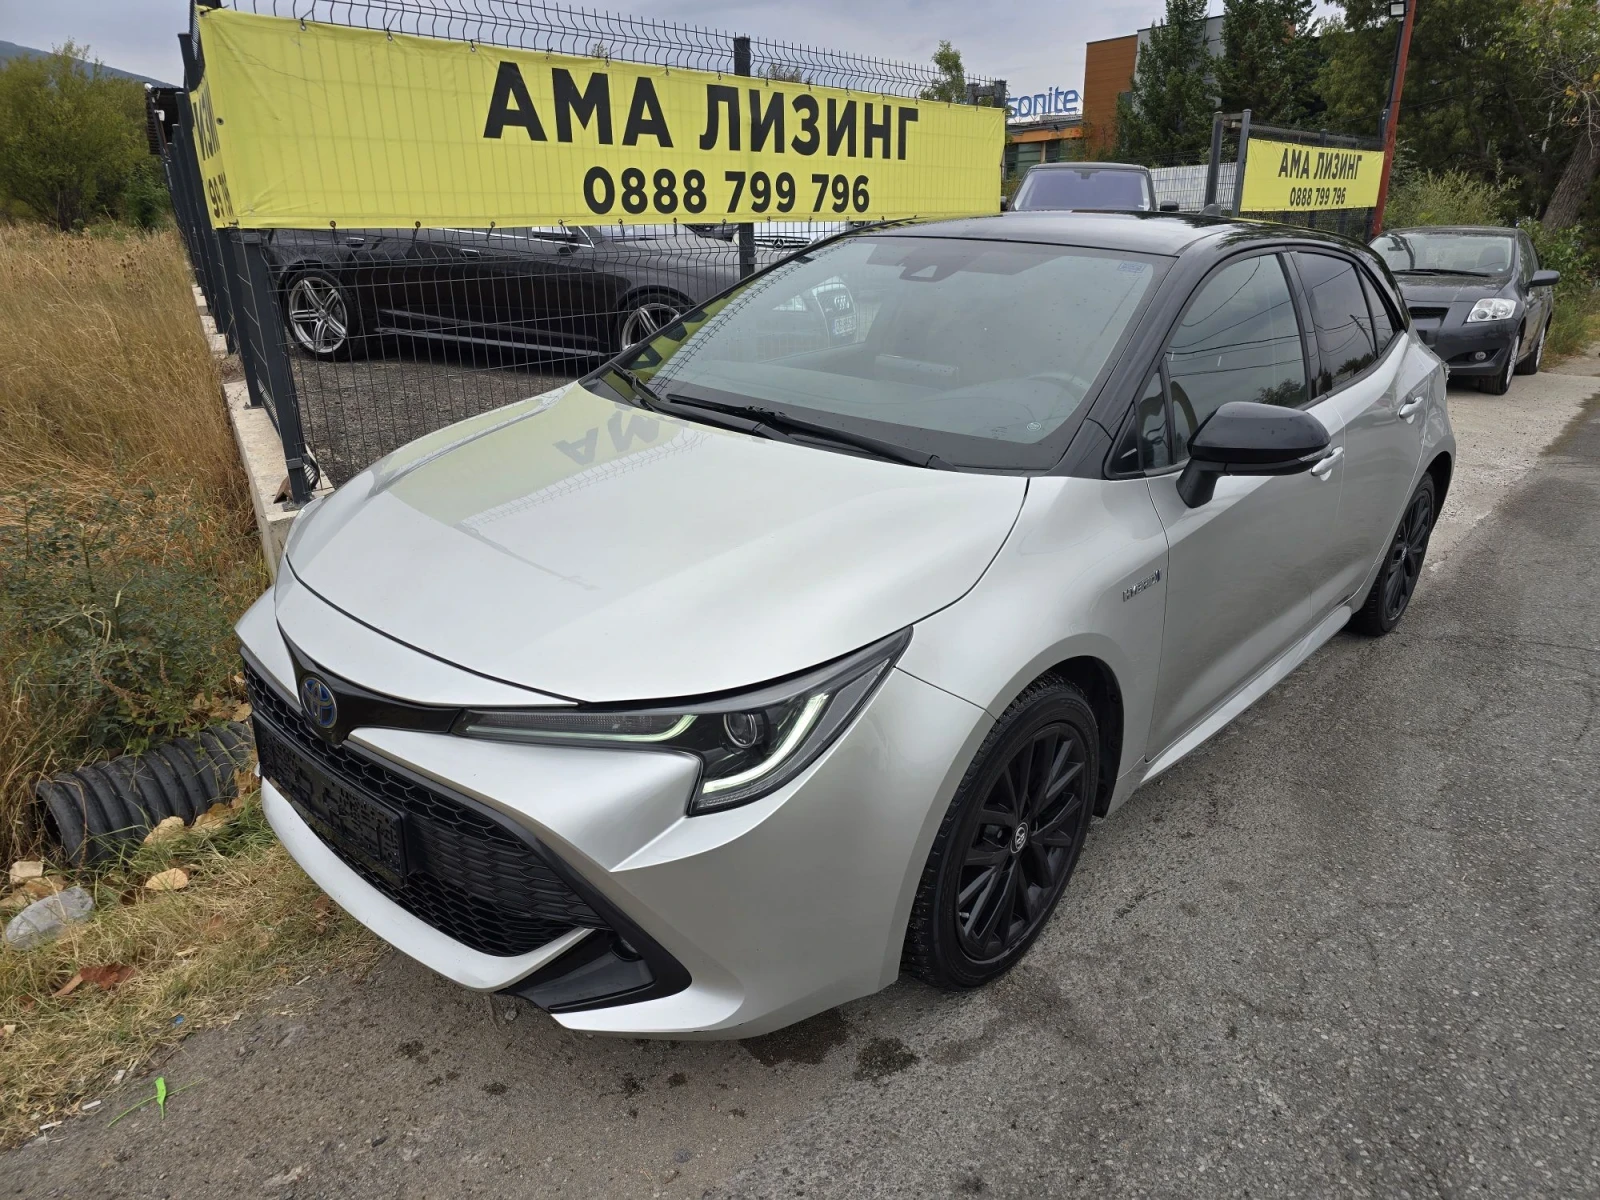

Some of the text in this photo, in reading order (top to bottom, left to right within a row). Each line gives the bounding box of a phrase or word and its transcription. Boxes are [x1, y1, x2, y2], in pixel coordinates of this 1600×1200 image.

[483, 60, 920, 161] АМА ЛИЗИНГ
[1006, 86, 1079, 118] sonite
[1277, 147, 1363, 180] АМА ЛИЗИНГ
[583, 166, 870, 215] 0888 799 796
[1289, 186, 1347, 207] 0888 799 796
